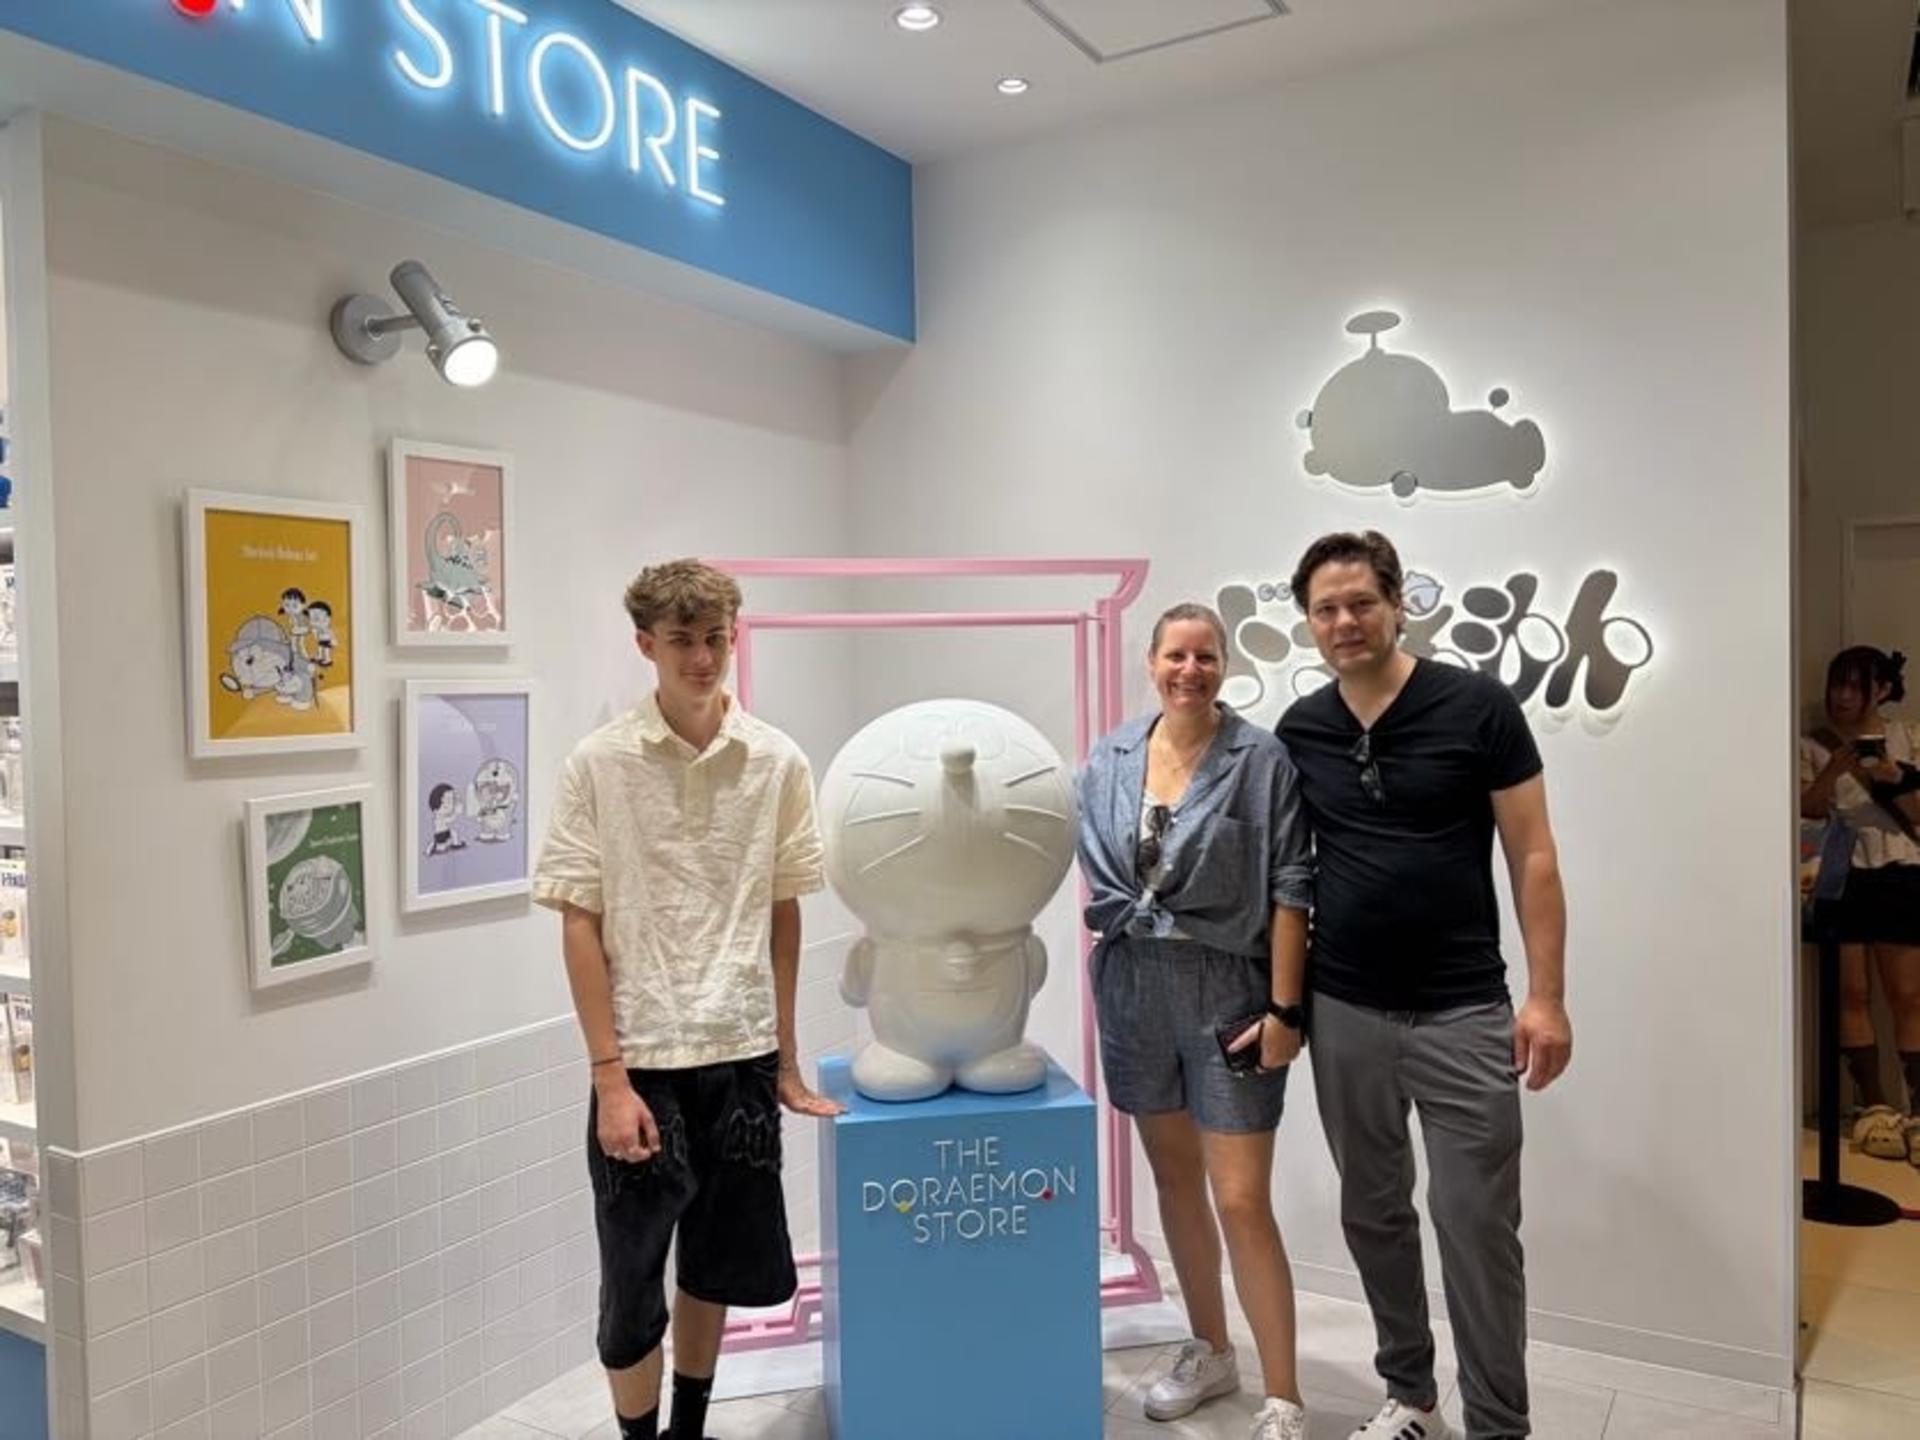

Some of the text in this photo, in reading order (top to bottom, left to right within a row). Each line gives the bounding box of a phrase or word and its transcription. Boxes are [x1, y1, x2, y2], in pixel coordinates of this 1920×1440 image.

[395, 0, 725, 206] STORE
[933, 1136, 1000, 1170] THE
[862, 1165, 1077, 1213] DORAEMON
[913, 1205, 1029, 1244] STORE
